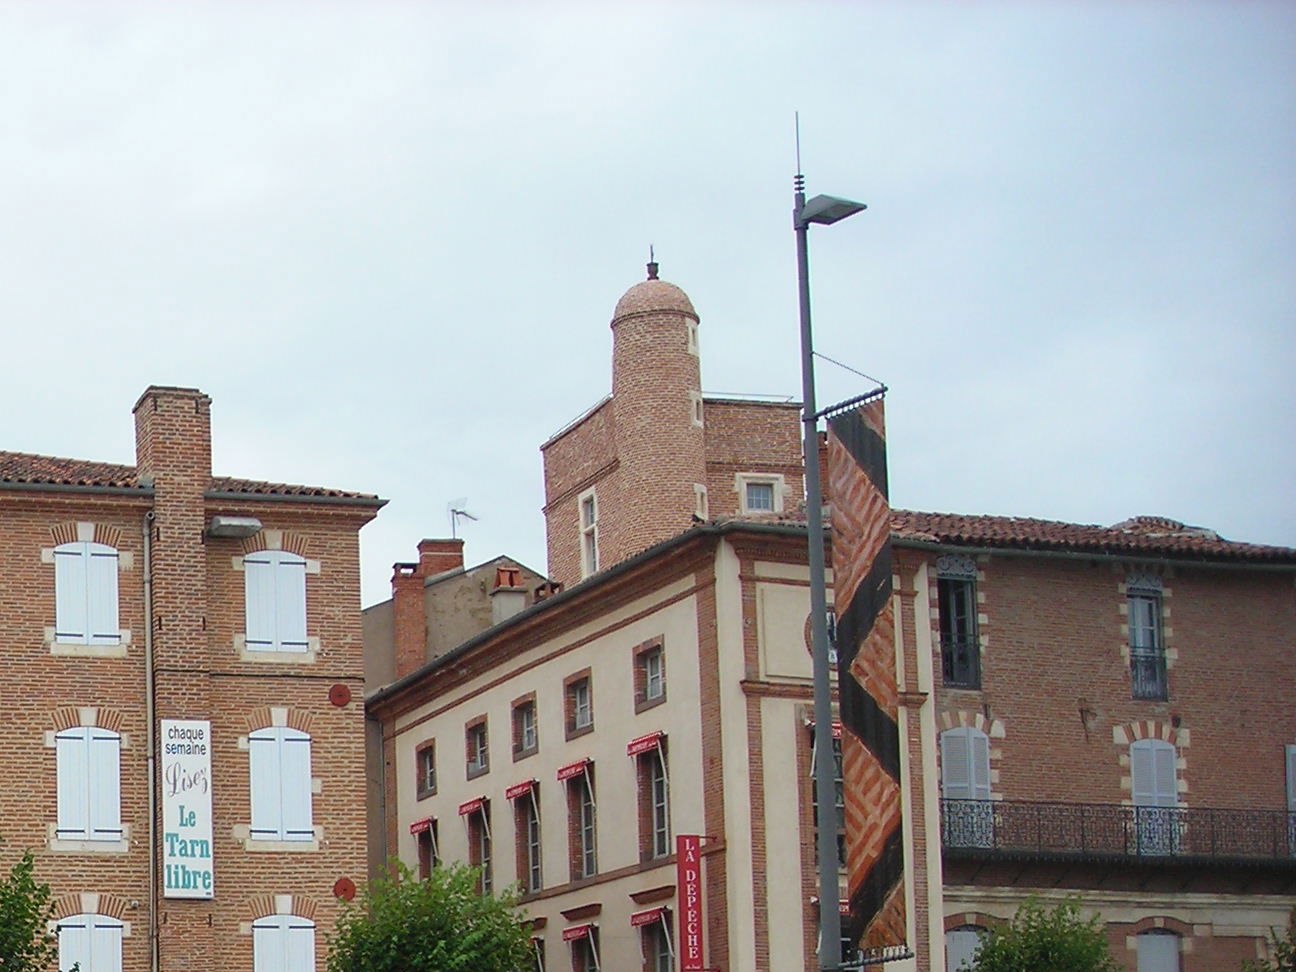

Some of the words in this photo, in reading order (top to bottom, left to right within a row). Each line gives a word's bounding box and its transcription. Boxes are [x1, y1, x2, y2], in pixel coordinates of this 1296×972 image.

[168, 726, 204, 742] chaque
[165, 742, 207, 755] semaine
[165, 762, 208, 797] Lisez
[178, 805, 196, 827] Le
[165, 833, 211, 858] Tarn
[685, 839, 696, 862] LA
[166, 864, 211, 890] libre
